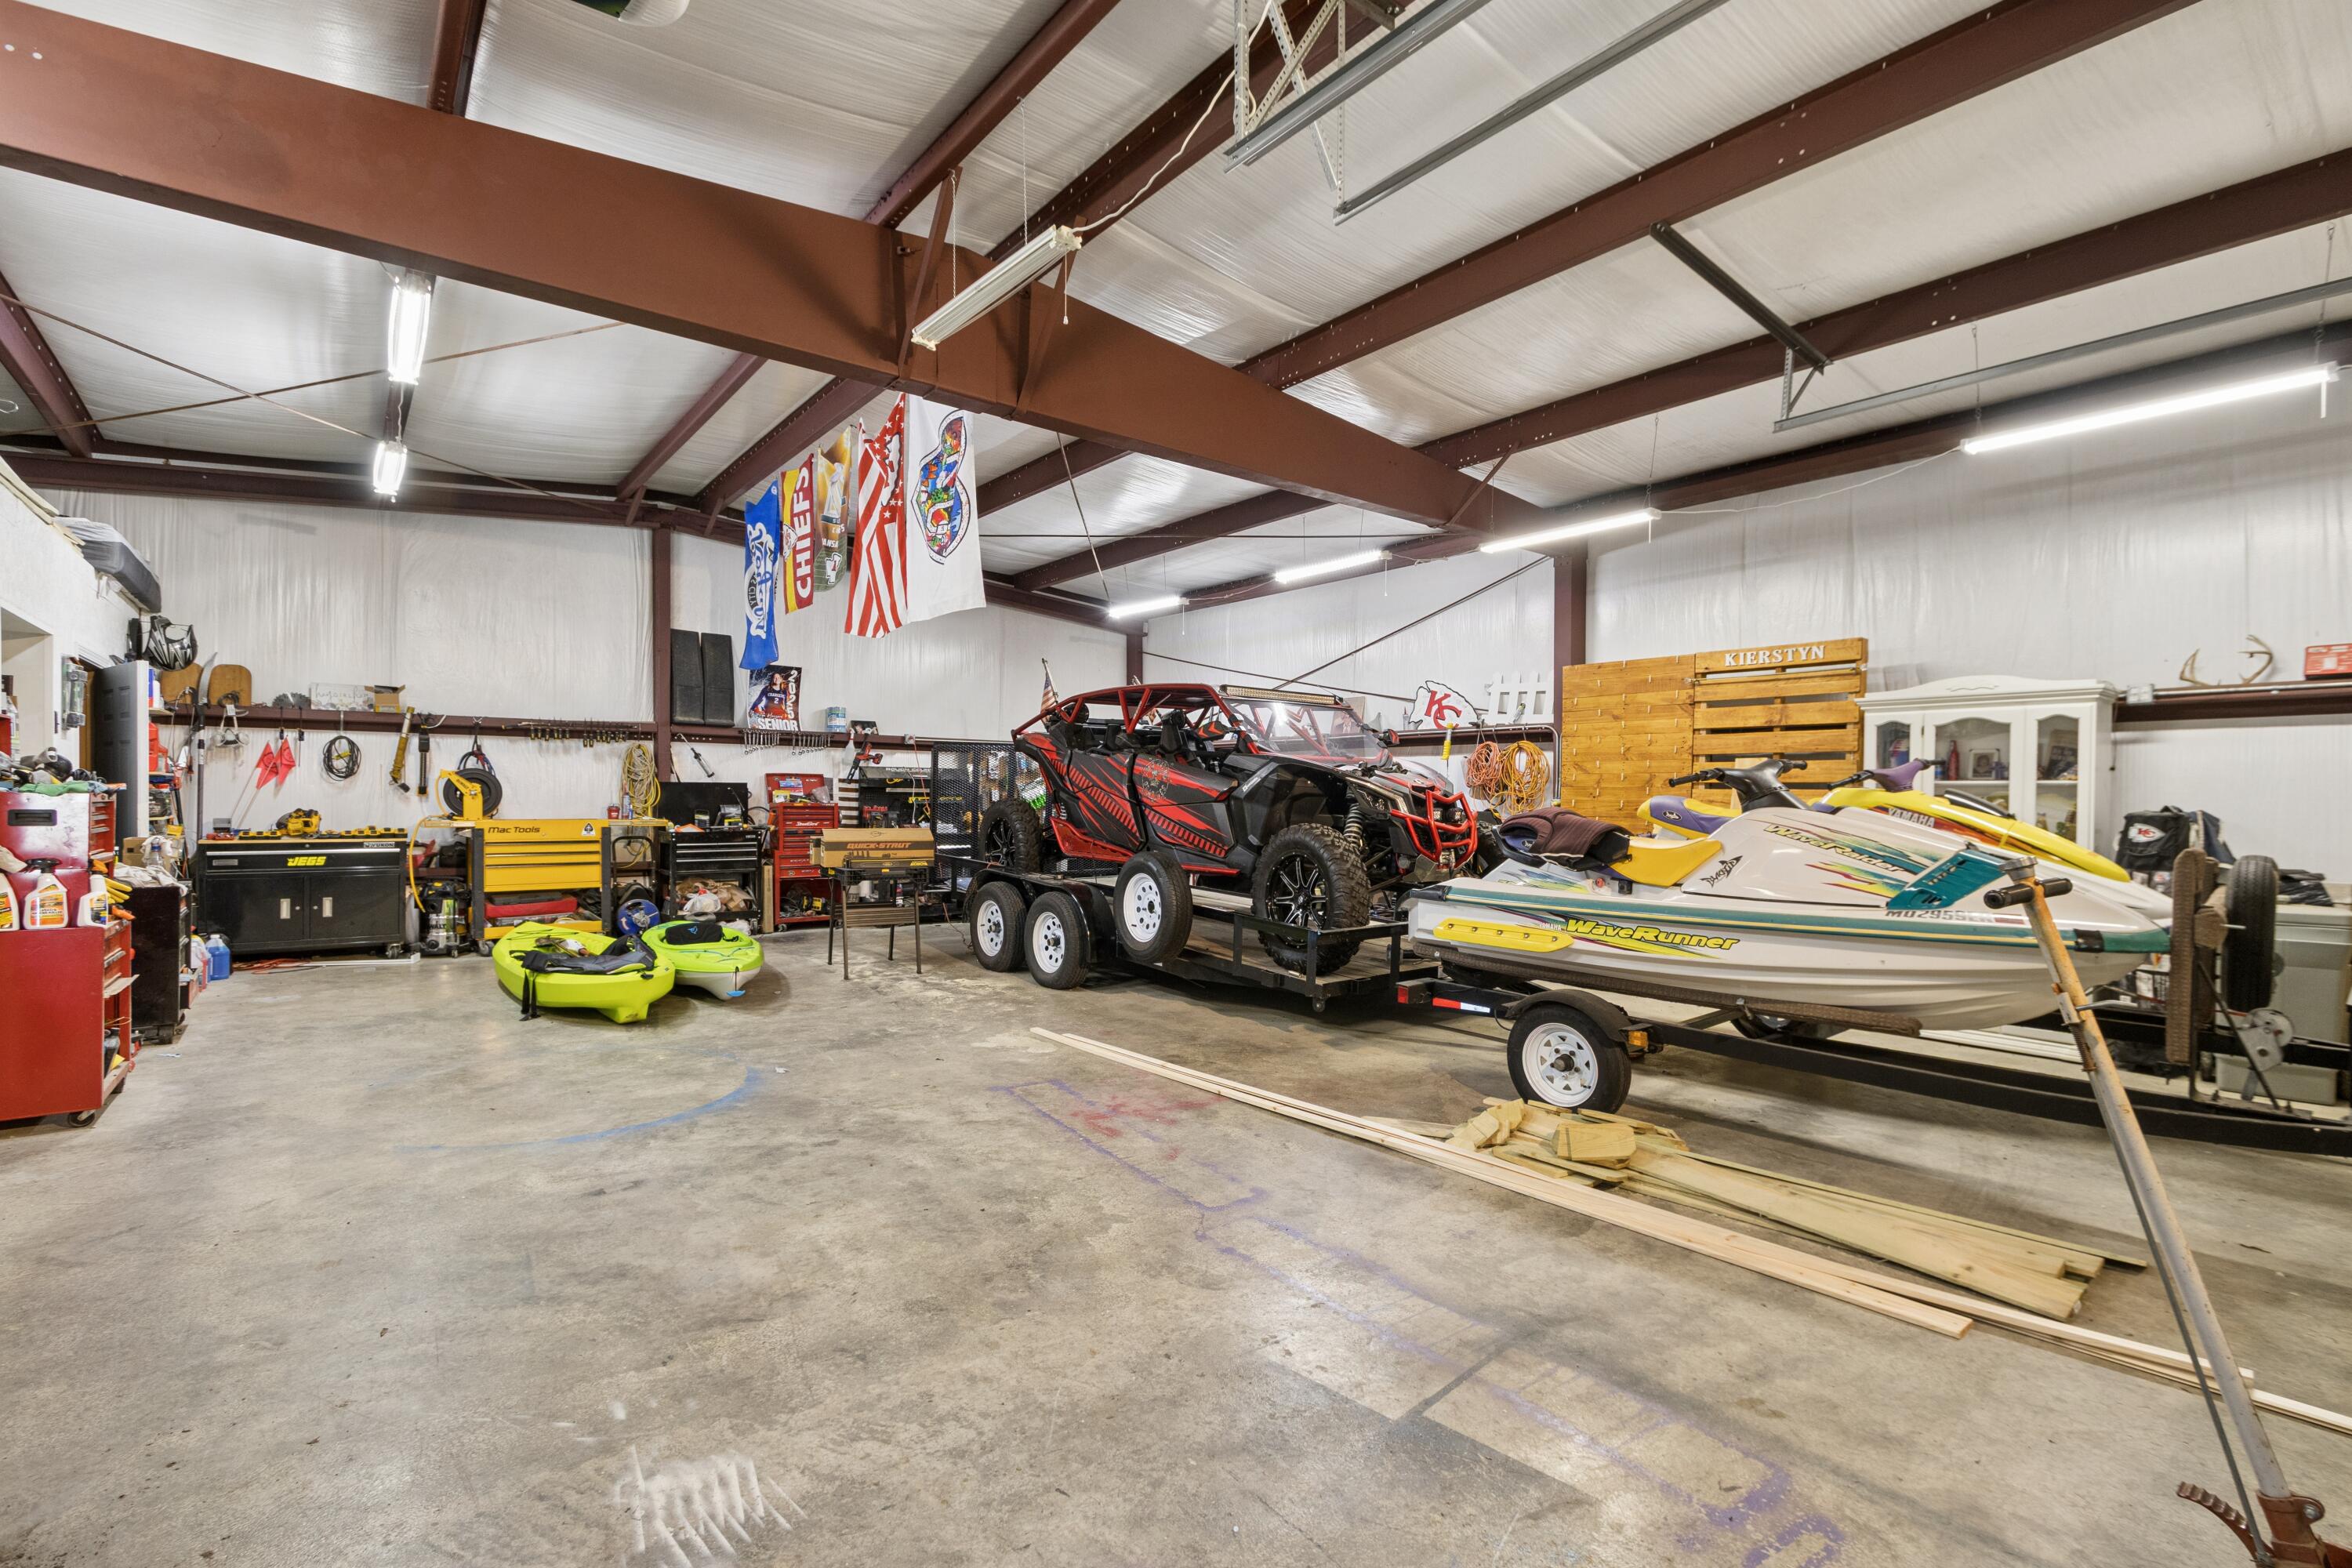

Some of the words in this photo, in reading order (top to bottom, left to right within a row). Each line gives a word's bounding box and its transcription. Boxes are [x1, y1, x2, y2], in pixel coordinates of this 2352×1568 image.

[793, 466, 811, 598] CHIEFS
[1725, 645, 1825, 666] KIERSTYN
[786, 670, 798, 719] 2025
[1425, 690, 1462, 730] KC
[757, 717, 798, 731] SENIOR
[1886, 807, 1935, 828] YAMAHA
[288, 855, 327, 866] JEGS
[1764, 823, 1908, 873] WaveRaider
[1566, 918, 1741, 950] WaveRunner
